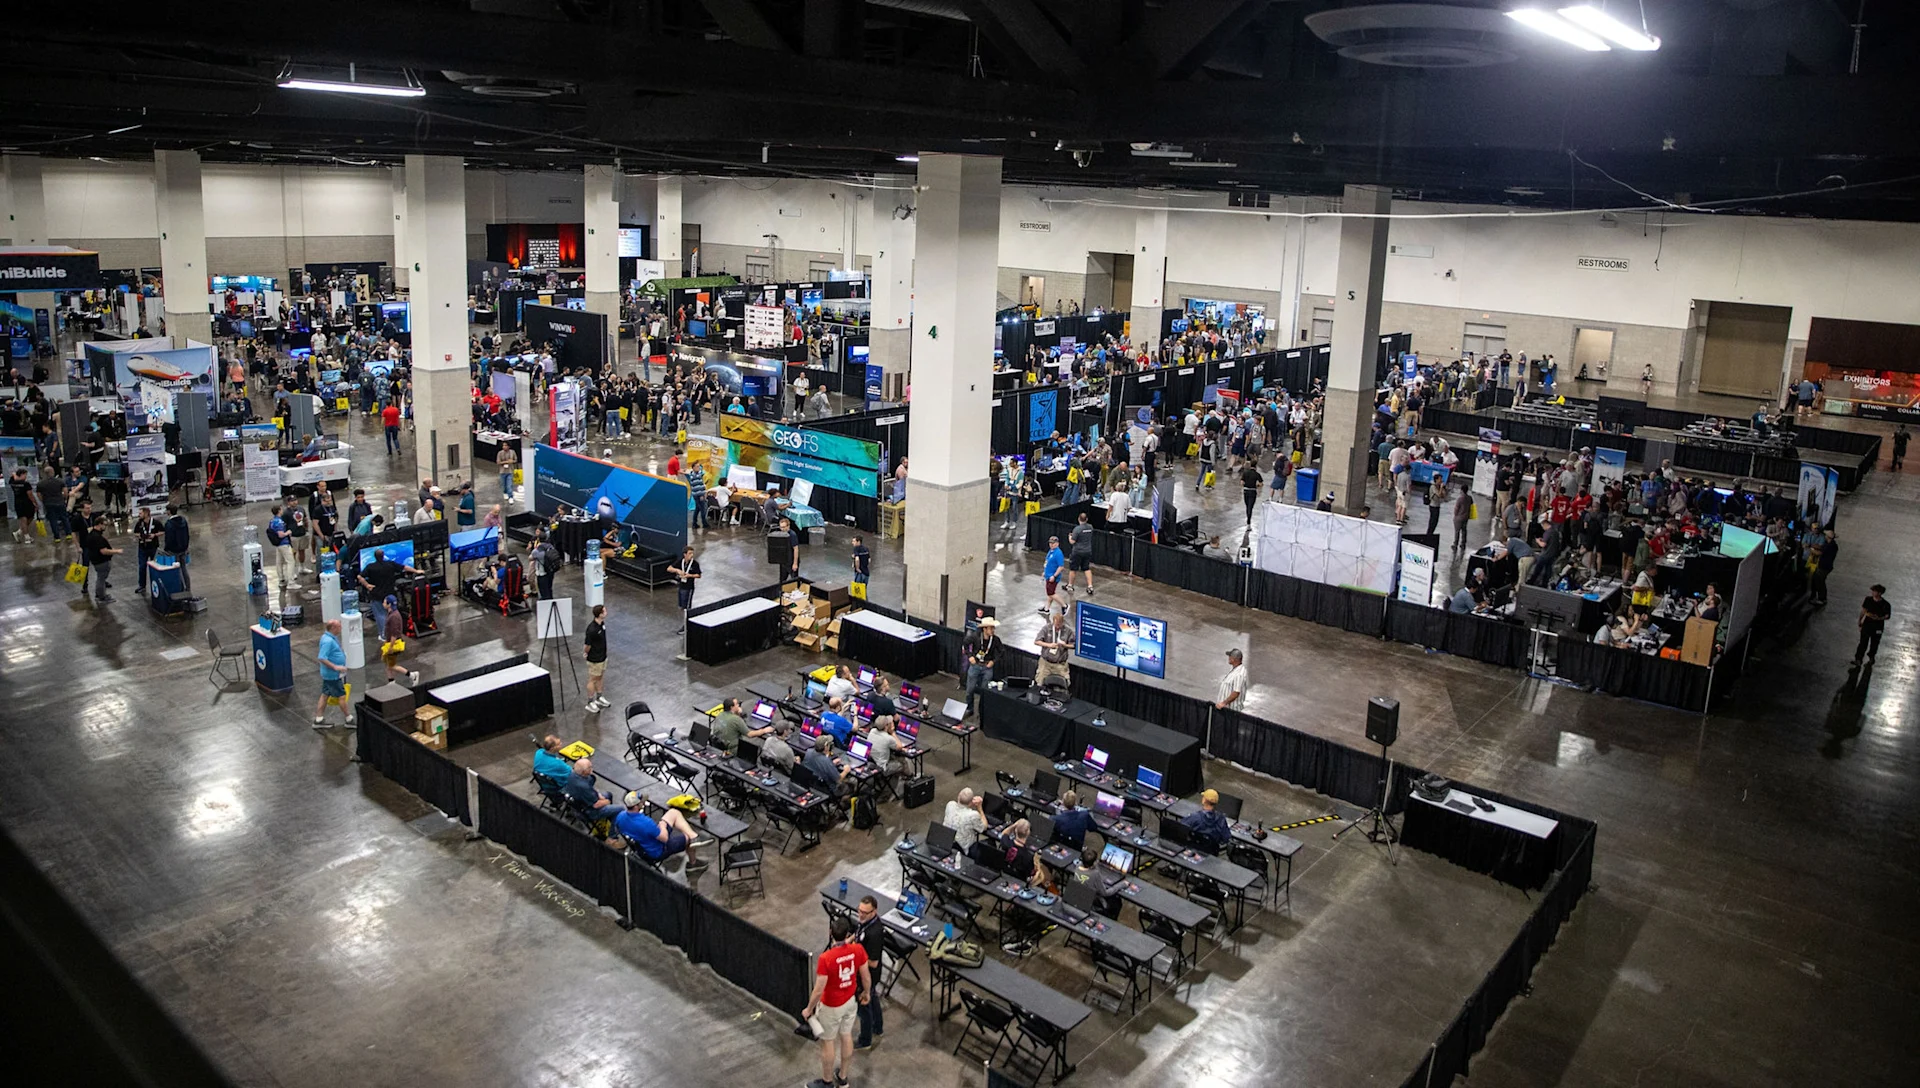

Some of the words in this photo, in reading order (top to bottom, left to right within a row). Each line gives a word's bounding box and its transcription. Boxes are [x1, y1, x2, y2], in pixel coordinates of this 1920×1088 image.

[1020, 222, 1049, 230] RESTROOMS
[1578, 258, 1628, 270] RESTROOMS
[1347, 291, 1355, 301] 5
[928, 325, 937, 339] 4
[678, 352, 706, 364] Navigraph
[1844, 374, 1891, 387] EXHIBITORS
[774, 456, 793, 466] Accessible
[793, 460, 805, 468] Flight
[804, 463, 823, 472] Simulator
[486, 853, 506, 864] X
[836, 953, 855, 965] GROUND
[839, 980, 853, 990] CREW
